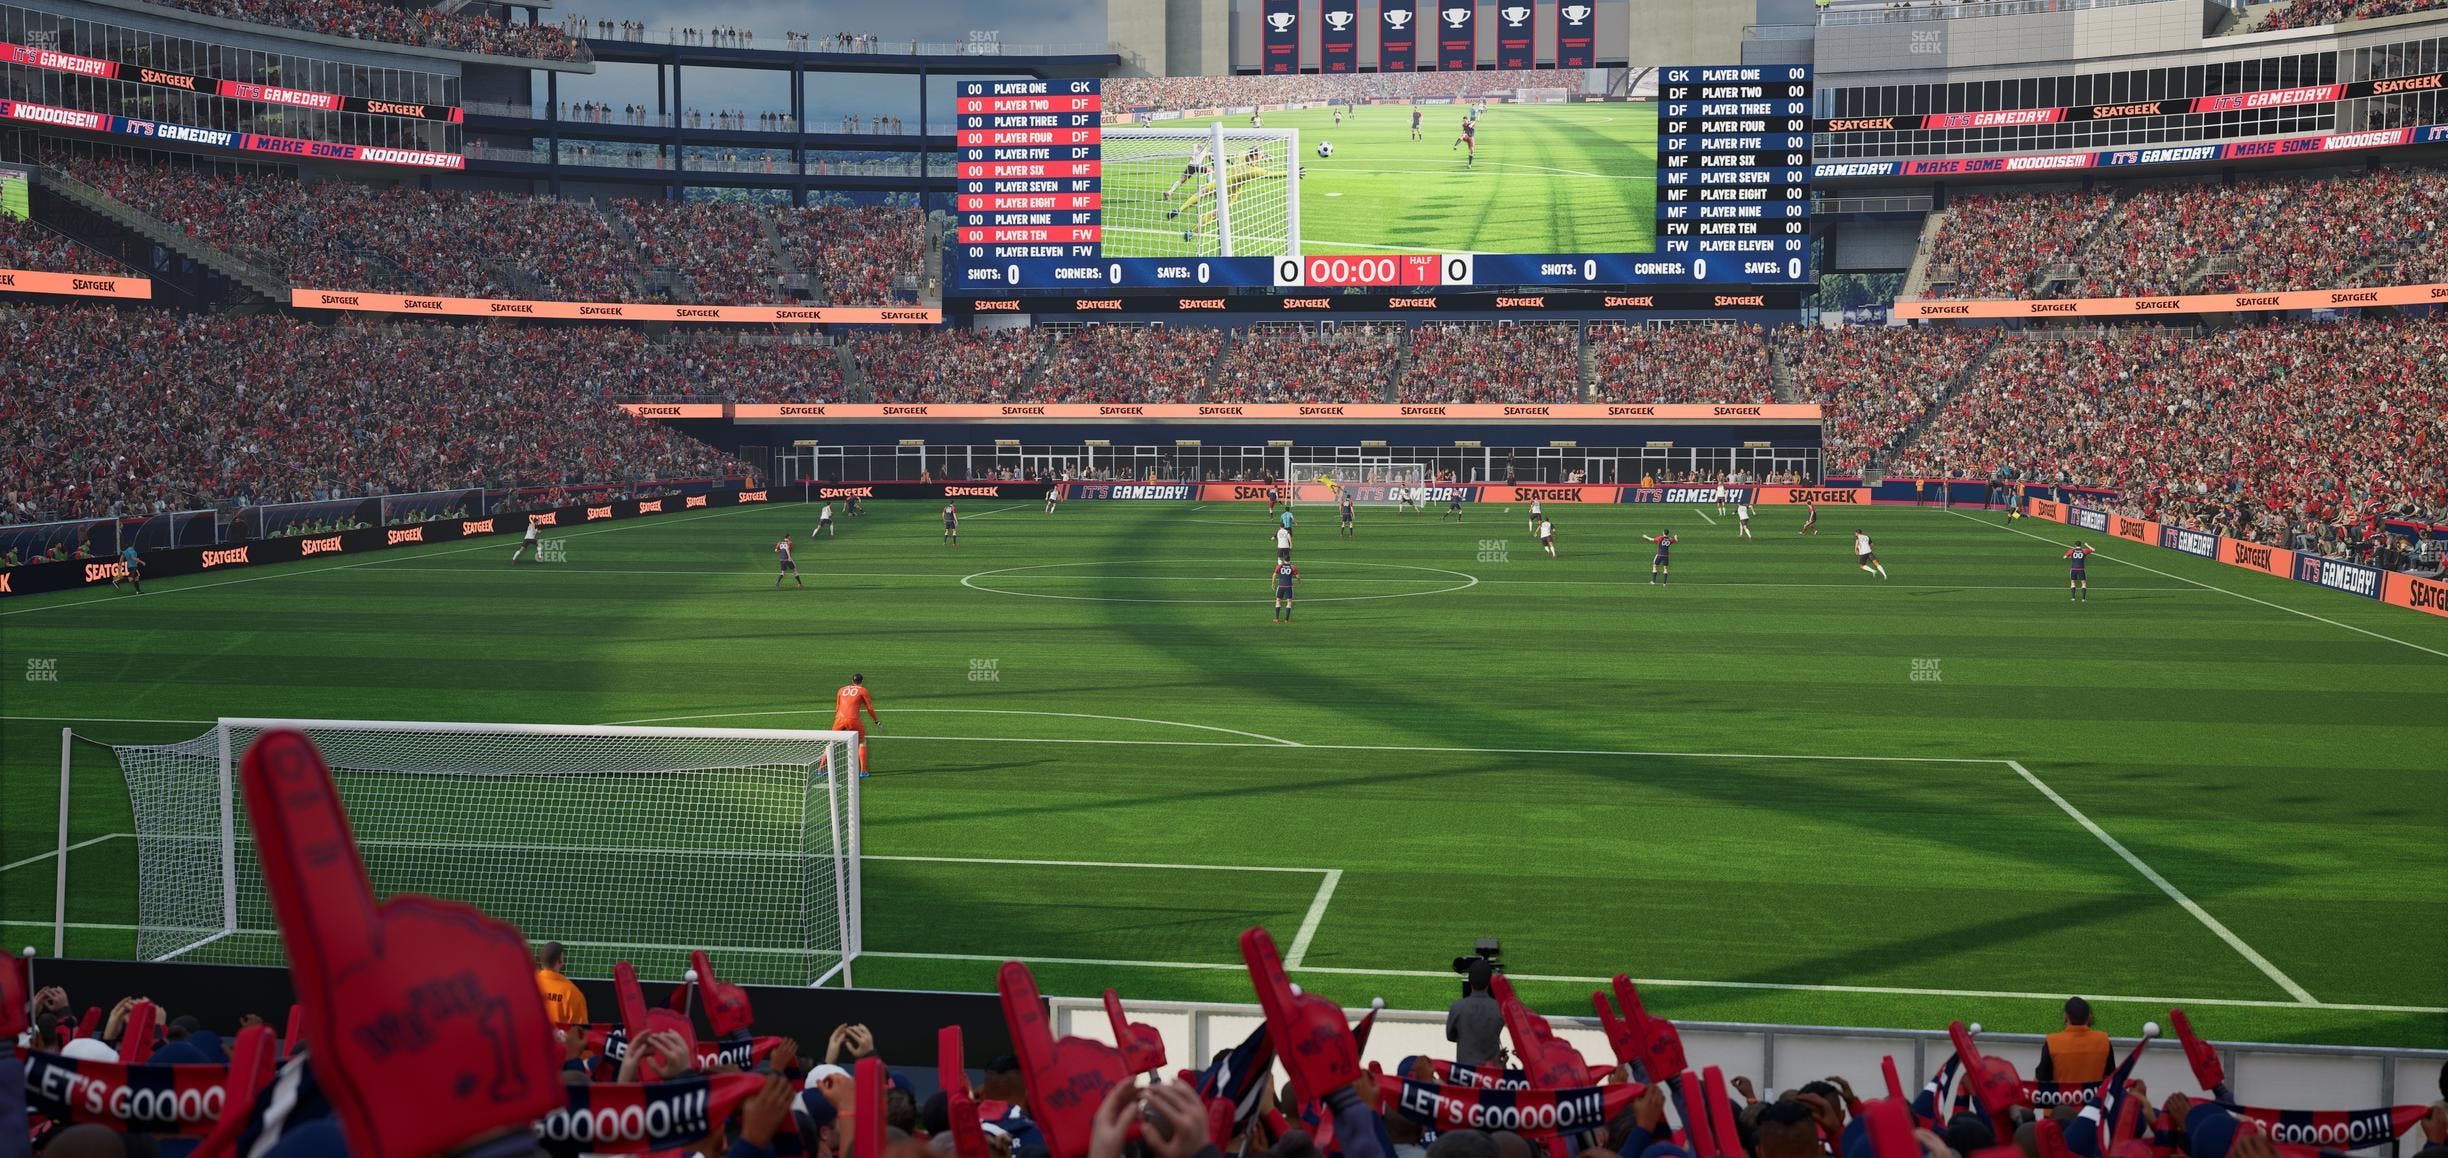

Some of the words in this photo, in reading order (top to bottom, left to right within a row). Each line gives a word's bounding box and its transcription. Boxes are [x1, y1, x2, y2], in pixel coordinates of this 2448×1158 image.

[12, 46, 37, 65] IT'S
[40, 50, 105, 76] GAMEDAY!
[142, 69, 195, 90] SEATGEEK
[1669, 71, 1688, 81] GK
[1703, 70, 1738, 80] PLAYER
[1741, 70, 1760, 80] ONE
[1790, 68, 1804, 79] 00
[968, 84, 982, 94] 00
[995, 84, 1027, 94] PLAYER
[1029, 83, 1046, 94] ONE
[1071, 82, 1089, 92] GK
[2374, 74, 2442, 94] SEATGEEK
[236, 84, 260, 99] IT'S
[264, 88, 330, 107] GAMEDAY!
[1670, 88, 1687, 98] DF
[1703, 87, 1738, 98] PLAYER
[1741, 87, 1762, 97] TWO
[1789, 86, 1804, 96] 00
[2214, 96, 2242, 110] IT'S
[2247, 87, 2332, 106] GAMEDAY!
[368, 101, 424, 117] SEATGEEK
[968, 101, 982, 111] 00
[995, 100, 1027, 110] PLAYER
[1030, 100, 1048, 110] TWO
[1072, 99, 1088, 109] DF
[1670, 105, 1687, 116] DF
[1703, 104, 1738, 115] PLAYER
[1740, 104, 1771, 114] THREE
[1789, 103, 1803, 114] 00
[2094, 102, 2160, 118] SEATGEEK
[14, 104, 98, 128] NOOOOISE!!!
[969, 117, 982, 127] 00
[995, 117, 1027, 126] PLAYER
[1030, 116, 1057, 126] THREE
[1072, 115, 1088, 125] DF
[1944, 112, 1970, 126] IT'S
[1974, 108, 2050, 125] GAMEDAY!
[1829, 118, 1894, 131] SEATGEEK
[126, 120, 154, 136] IT'S
[158, 124, 231, 145] GAMEDAY!
[969, 133, 982, 143] 00
[995, 133, 1027, 143] PLAYER
[1030, 132, 1052, 142] FOUR
[1072, 132, 1088, 142] DF
[2235, 142, 2276, 156] MAKE
[2282, 139, 2320, 152] SOME
[2324, 130, 2402, 149] NOOOOISE!!!
[257, 138, 303, 152] MAKE
[312, 144, 355, 158] SOME
[360, 148, 460, 167] NOOOOISE!!!
[969, 150, 982, 160] 00
[995, 149, 1027, 159] PLAYER
[1030, 149, 1049, 158] FIVE
[1072, 148, 1088, 158] DF
[2110, 150, 2138, 165] IT'S
[2142, 147, 2215, 162] GAMEDAY!
[969, 166, 982, 176] 00
[996, 166, 1028, 176] PLAYER
[1030, 166, 1044, 175] SIX
[1073, 164, 1090, 174] MF
[1815, 163, 1892, 176] GAMEDAY!
[1916, 162, 1959, 172] MAKE
[1965, 160, 2003, 170] SOME
[2007, 154, 2086, 169] NOOOOISE!!!
[969, 182, 982, 192] 00
[996, 182, 1028, 192] PLAYER
[1030, 182, 1058, 191] SEVEN
[1073, 181, 1090, 191] MF
[969, 198, 982, 208] 00
[996, 198, 1028, 208] PLAYER
[1030, 198, 1056, 208] EIGHT
[1073, 197, 1090, 207] MF
[970, 215, 982, 225] 00
[996, 214, 1028, 224] PLAYER
[1030, 214, 1050, 224] NINE
[1073, 214, 1090, 224] MF
[970, 231, 983, 240] 00
[996, 230, 1028, 240] PLAYER
[1030, 230, 1047, 240] TEN
[1073, 230, 1092, 240] FW
[970, 247, 983, 257] 00
[996, 247, 1028, 257] PLAYER
[1031, 247, 1063, 256] ELEVEN
[1073, 246, 1092, 256] FW
[968, 269, 1000, 279] SHOTS:
[1008, 265, 1019, 284] 0
[1056, 268, 1101, 278] CORNERS:
[1110, 264, 1121, 283] 0
[1158, 267, 1190, 278] SAVES:
[1198, 263, 1209, 283] 0
[1281, 261, 1298, 282] 0
[1311, 259, 1395, 282] 00:00
[1417, 266, 1423, 281] 1
[1448, 259, 1466, 280] 0
[1542, 264, 1576, 275] SHOTS:
[1584, 260, 1596, 280] 0
[1635, 263, 1685, 274] CORNERS:
[1694, 259, 1706, 279] 0
[1745, 262, 1780, 273] SAVES:
[1789, 258, 1800, 278] 0
[73, 279, 115, 292] SEATGEEK
[322, 295, 358, 306] SEATGEEK
[1284, 299, 1330, 308] SEATGEEK
[1605, 296, 1653, 306] SEATGEEK
[2332, 292, 2377, 303] SEATGEEK
[580, 307, 622, 315] SEATGEEK
[976, 300, 1019, 310] SEATGEEK
[1921, 306, 1968, 314] SEATGEEK
[2136, 300, 2179, 310] SEATGEEK
[882, 312, 928, 320] SEATGEEK
[780, 407, 824, 415] SEATGEEK
[1300, 407, 1343, 415] SEATGEEK
[1609, 407, 1654, 415] SEATGEEK
[739, 491, 767, 502] SEATGEEK
[945, 487, 998, 496] SEATGEEK
[1081, 486, 1108, 499] IT'S
[1113, 486, 1188, 499] GAMEDAY!
[1514, 488, 1582, 502] SEATGEEK
[1634, 488, 1662, 502] IT'S
[1790, 490, 1857, 503] SEATGEEK
[388, 527, 422, 544] SEATGEEK
[2120, 518, 2145, 541] SEATGEEK
[302, 536, 342, 555] SEATGEEK
[2166, 528, 2178, 549] IT'S
[2179, 530, 2214, 556] GAMEDAY!
[202, 546, 248, 567] SEATGEEK
[2236, 543, 2271, 572] SEATGEEK
[2302, 556, 2320, 583] IT'S
[2322, 560, 2376, 595] GAMEDAY!
[842, 688, 858, 696] 00
[24, 1056, 107, 1114] LET'S
[2031, 1088, 2098, 1105] GOOOOO
[1401, 1084, 1464, 1124] LET'S
[1468, 1093, 1602, 1130] GOOOOO!!!
[2272, 1113, 2390, 1144] GOOOOO!!!
